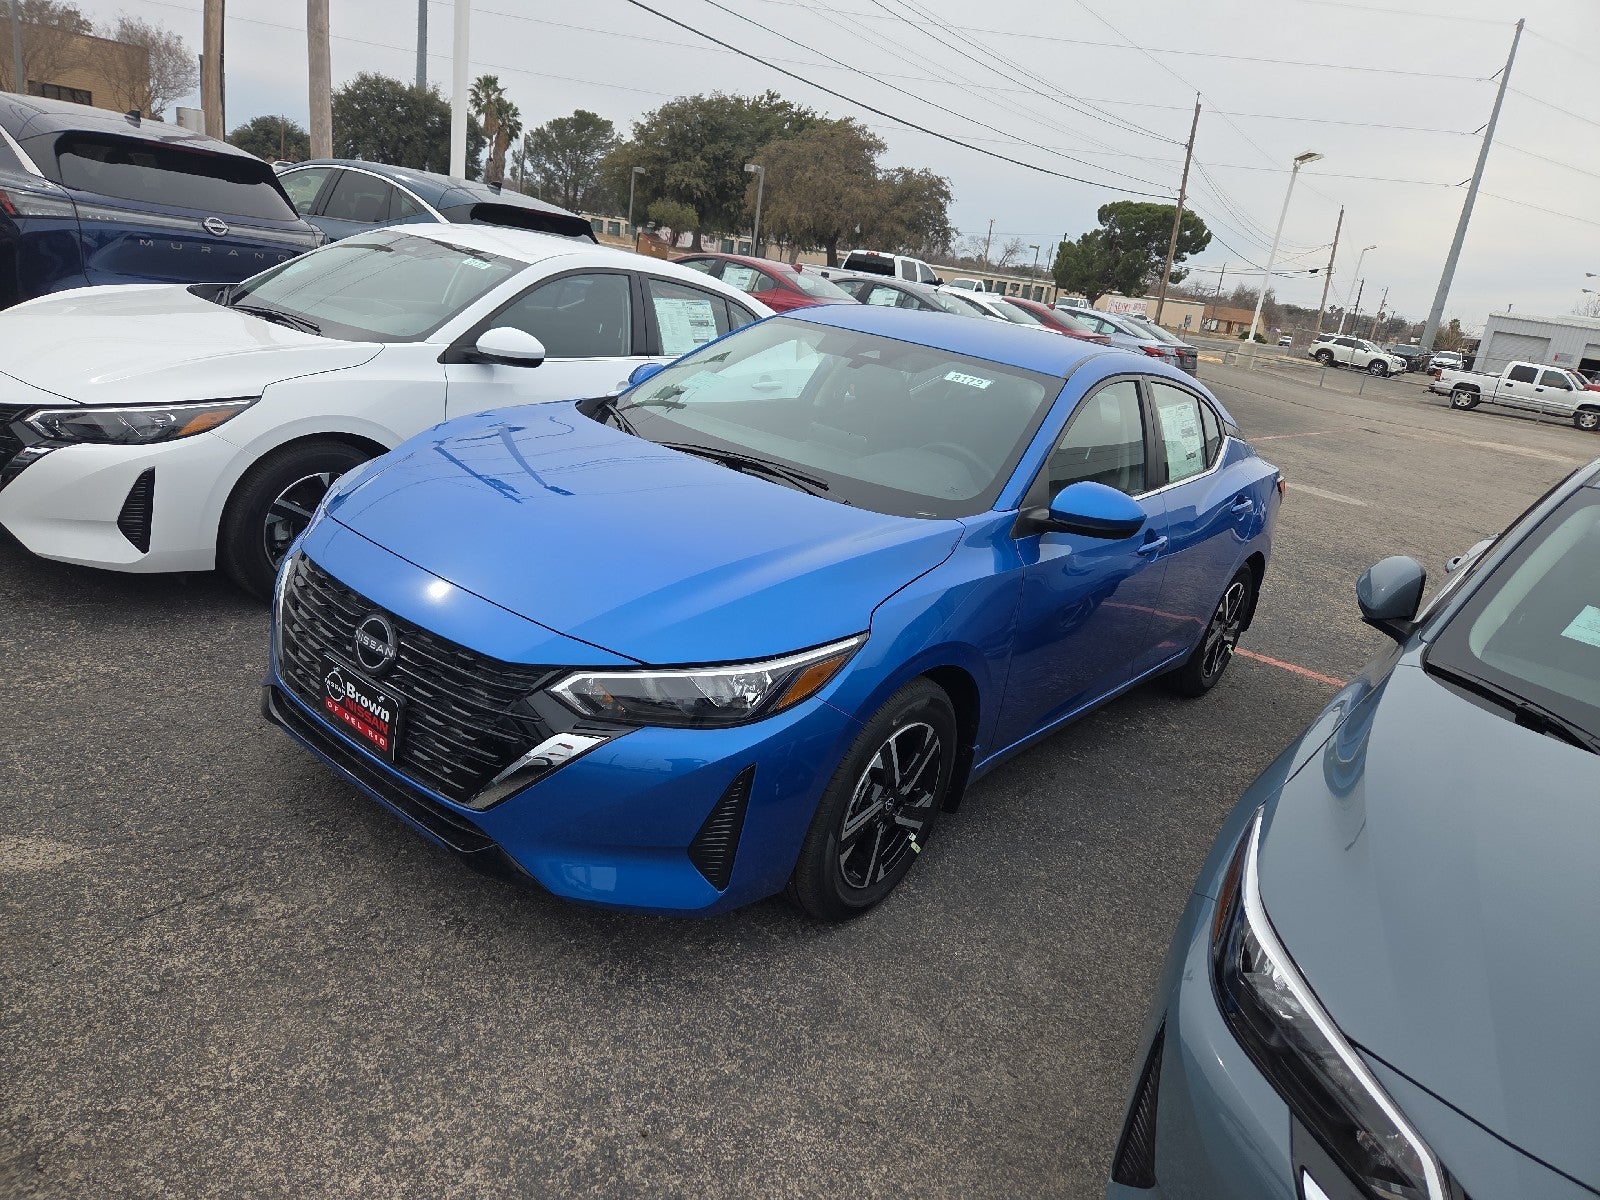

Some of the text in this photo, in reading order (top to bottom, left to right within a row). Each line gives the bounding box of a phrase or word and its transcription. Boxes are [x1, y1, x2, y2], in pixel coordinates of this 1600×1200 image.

[139, 238, 287, 262] MURANO
[355, 629, 395, 658] NISSAN
[345, 696, 388, 735] NISSAN
[346, 681, 390, 723] Brown
[327, 701, 385, 746] OF DEL RIO
